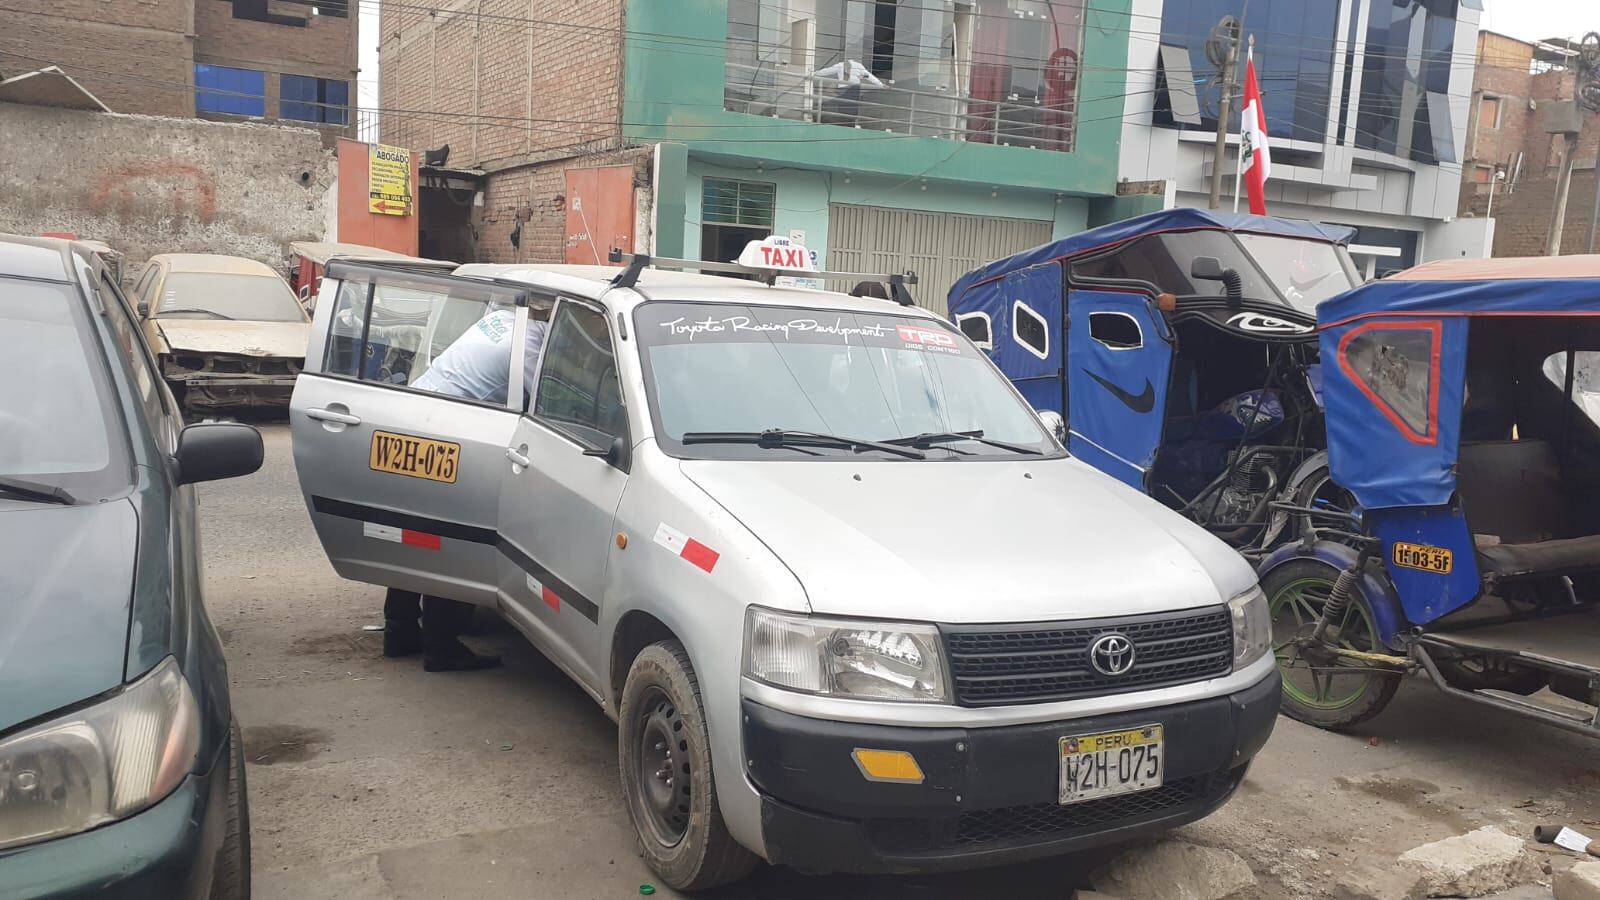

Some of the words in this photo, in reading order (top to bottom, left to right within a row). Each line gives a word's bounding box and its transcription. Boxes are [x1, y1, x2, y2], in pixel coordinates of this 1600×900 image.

[377, 150, 409, 163] ABOGADO
[760, 246, 804, 268] TAXI
[660, 316, 725, 341] Toyota
[722, 316, 789, 340] Racing
[899, 328, 953, 346] TRD
[375, 435, 456, 479] W2H-075
[1398, 549, 1449, 570] 1503-5F
[1096, 735, 1131, 749] PERU
